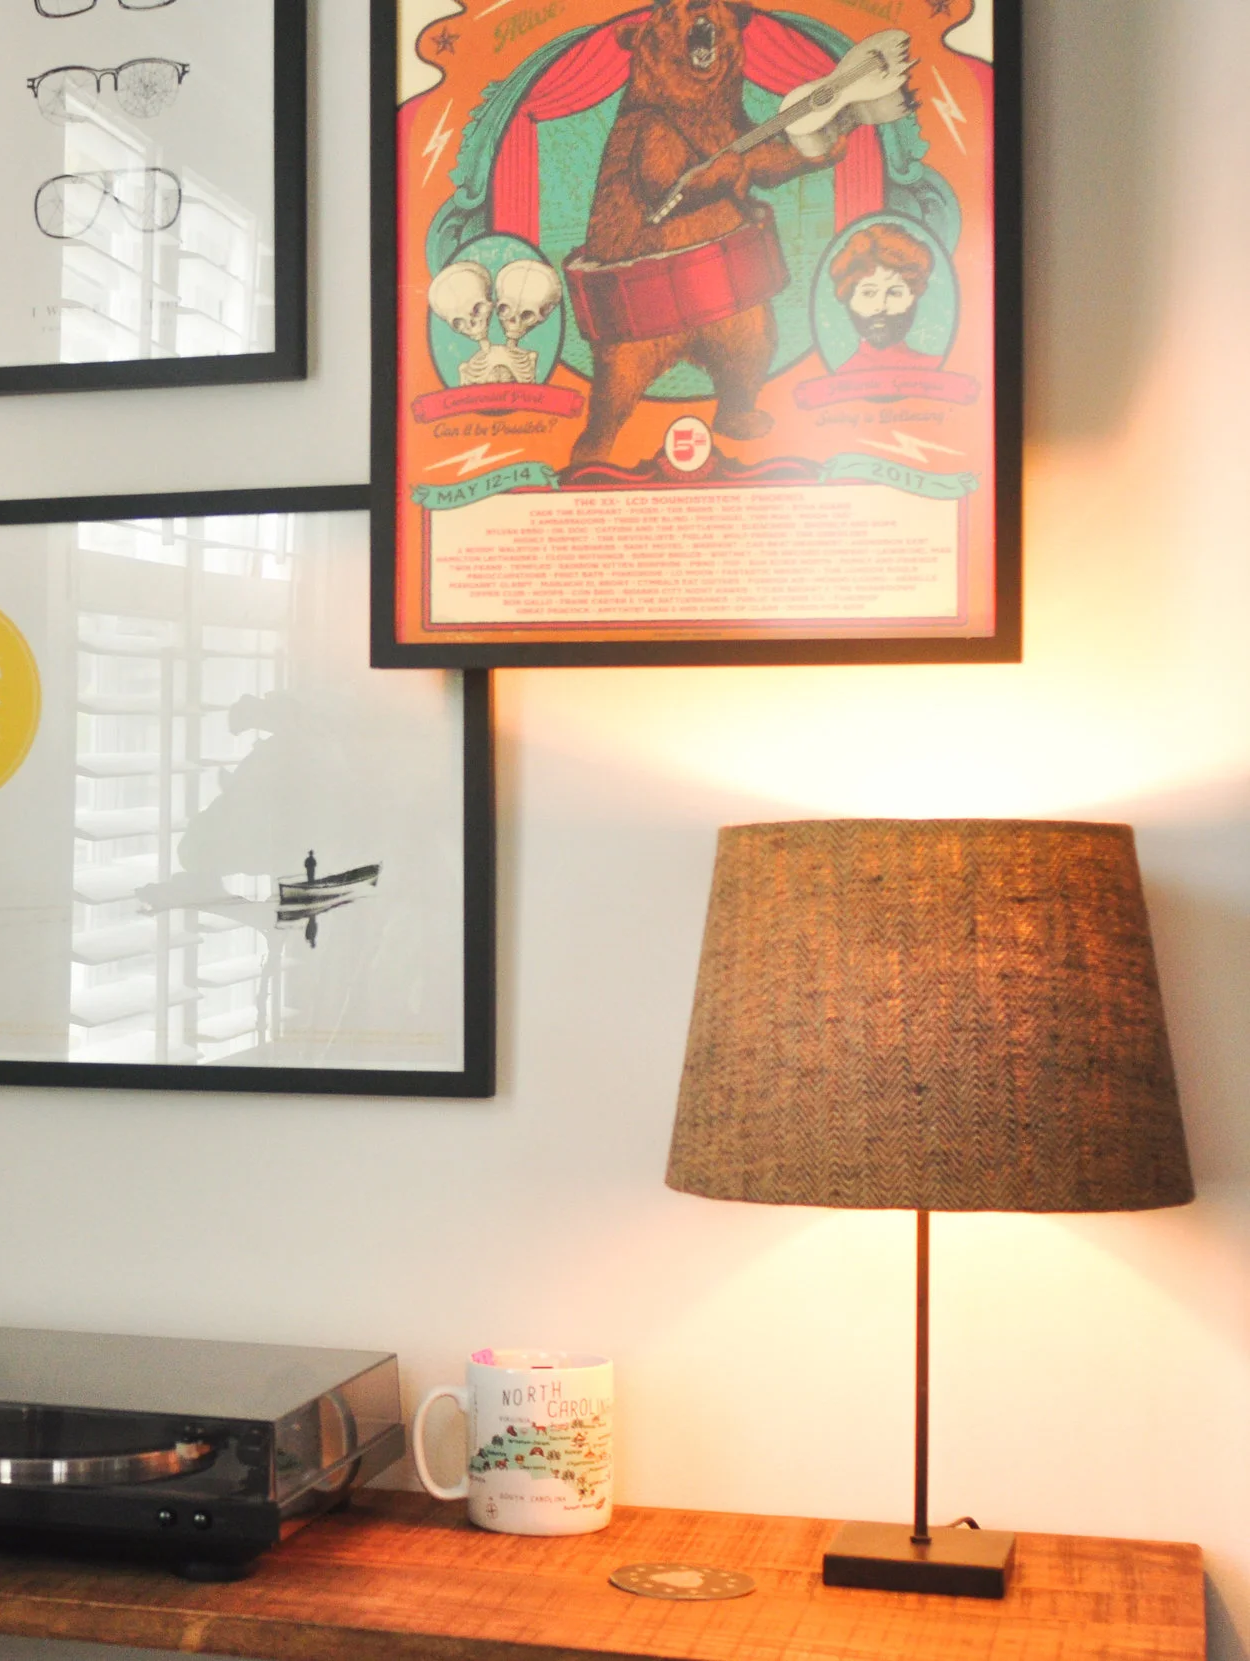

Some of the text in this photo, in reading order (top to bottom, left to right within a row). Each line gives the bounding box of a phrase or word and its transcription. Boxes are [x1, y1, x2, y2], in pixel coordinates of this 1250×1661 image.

[433, 422, 459, 438] Can
[437, 467, 531, 504] MAY 12-14
[872, 461, 927, 490] 2017
[575, 498, 596, 506] THE
[626, 497, 648, 506] LCD
[502, 1380, 562, 1406] NORTH
